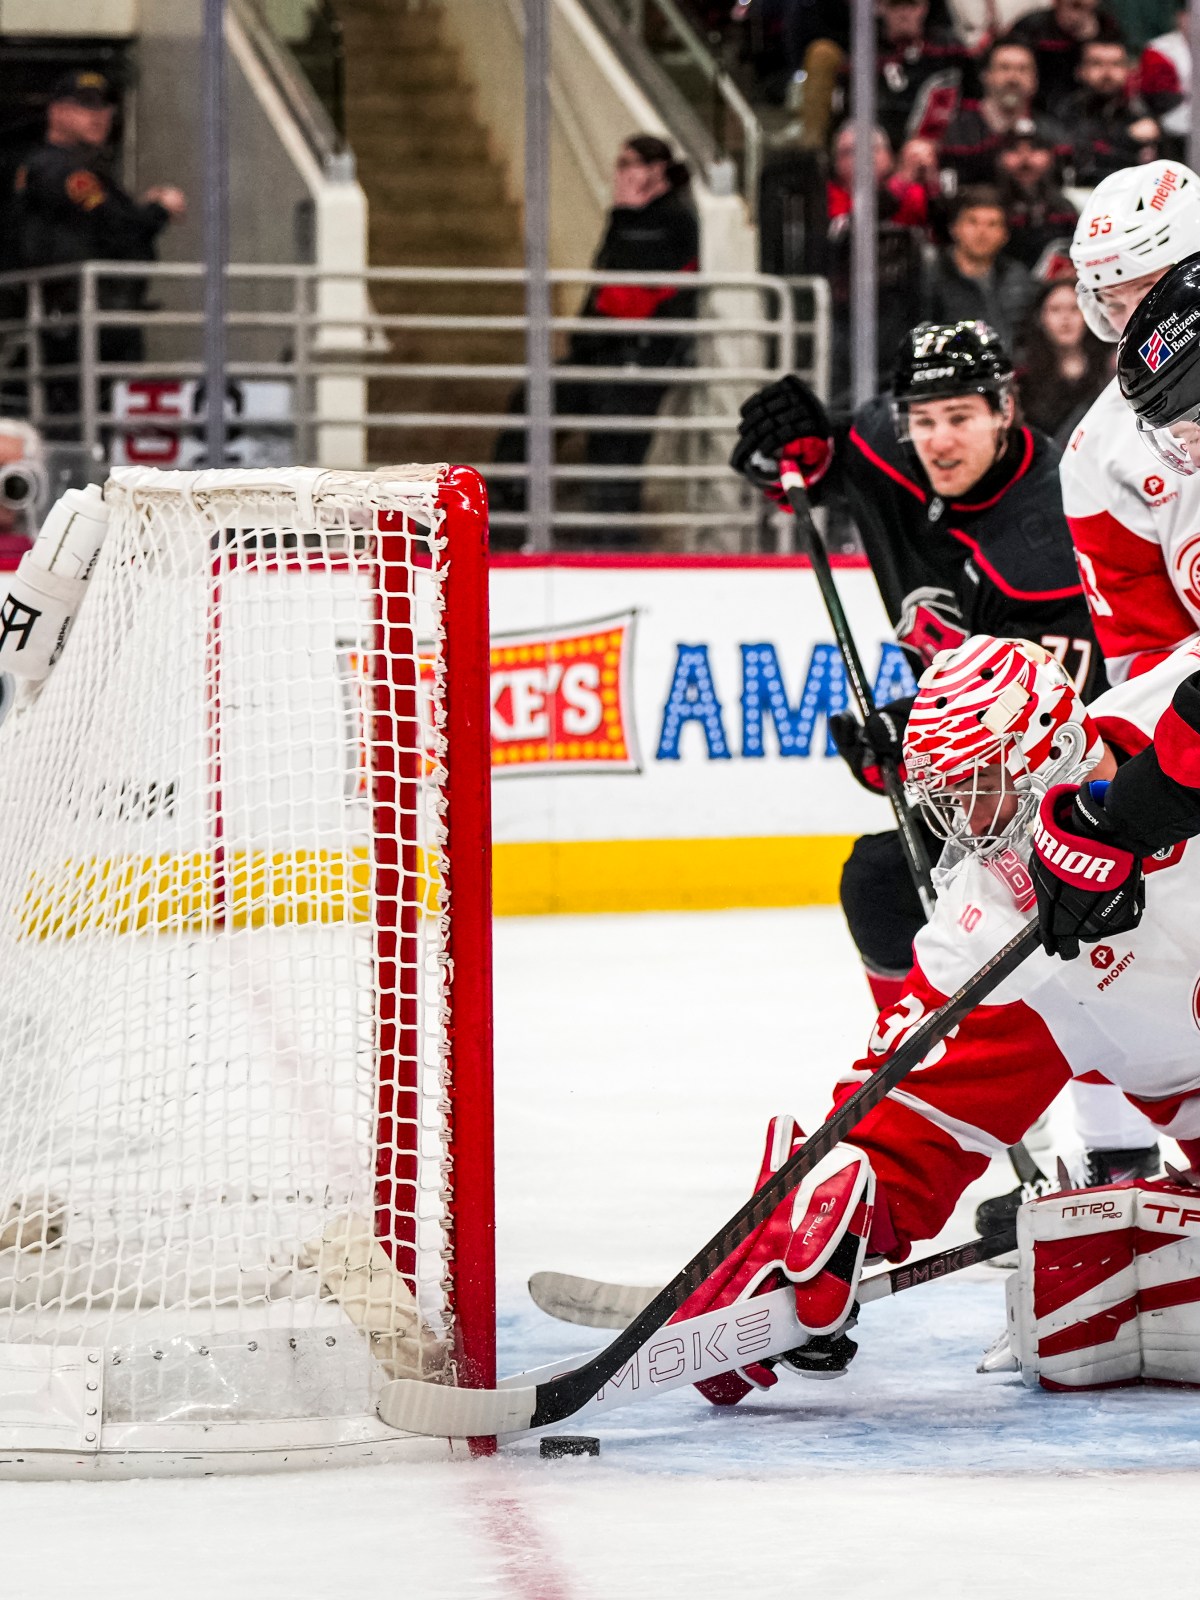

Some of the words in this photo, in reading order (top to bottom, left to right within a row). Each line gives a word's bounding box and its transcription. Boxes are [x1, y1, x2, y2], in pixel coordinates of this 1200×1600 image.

[1150, 169, 1178, 211] meijer
[1157, 312, 1180, 334] First
[1164, 310, 1200, 342] Citizens
[1170, 328, 1197, 353] Bank
[905, 754, 931, 769] AUER
[1101, 891, 1125, 918] COVERT
[1097, 951, 1136, 992] PRIORITY
[1062, 1201, 1115, 1219] NITRO
[1101, 1210, 1123, 1221] PRO
[895, 1248, 977, 1290] SMOKE
